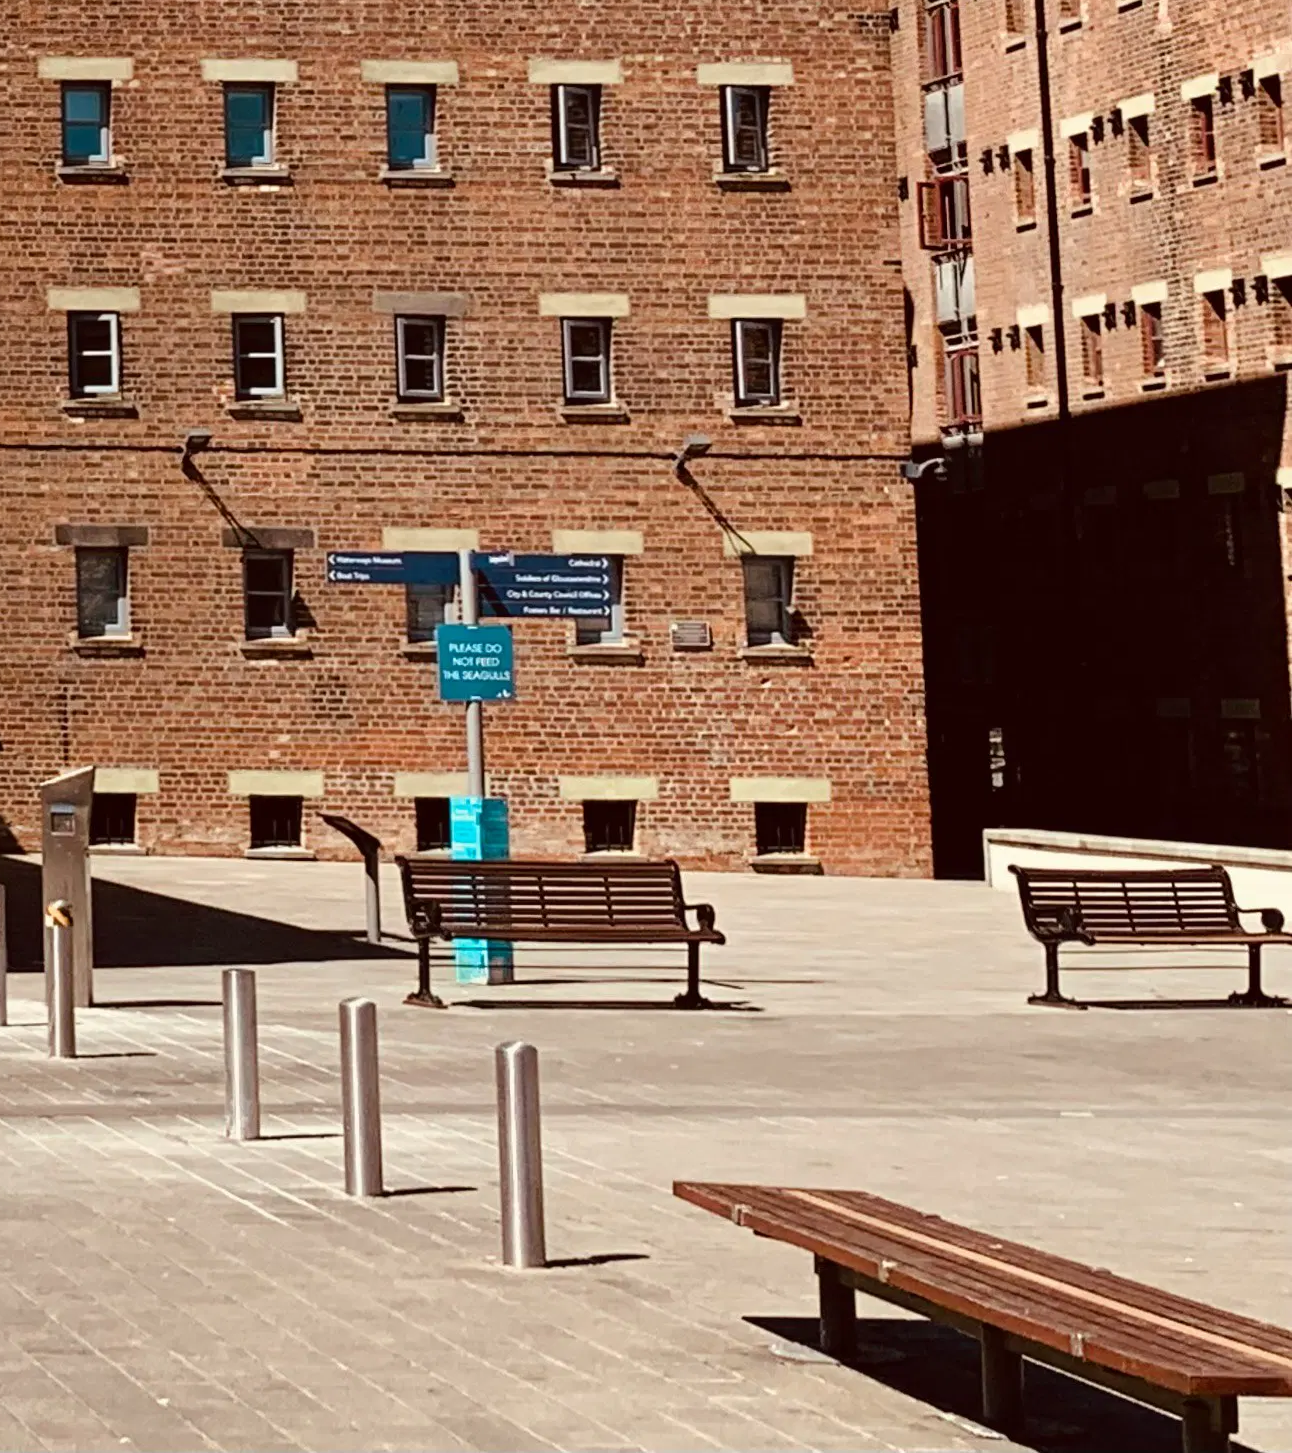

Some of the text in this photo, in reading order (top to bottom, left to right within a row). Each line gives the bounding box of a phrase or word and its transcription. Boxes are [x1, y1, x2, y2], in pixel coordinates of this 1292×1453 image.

[568, 558, 601, 567] Cathedral
[354, 572, 370, 580] Trips
[506, 589, 521, 599] City
[528, 589, 552, 599] County
[553, 590, 577, 599] Council
[449, 643, 502, 654] PLEASE DO
[452, 657, 500, 667] NOT FEED
[443, 670, 511, 681] THE SEAGULLS
